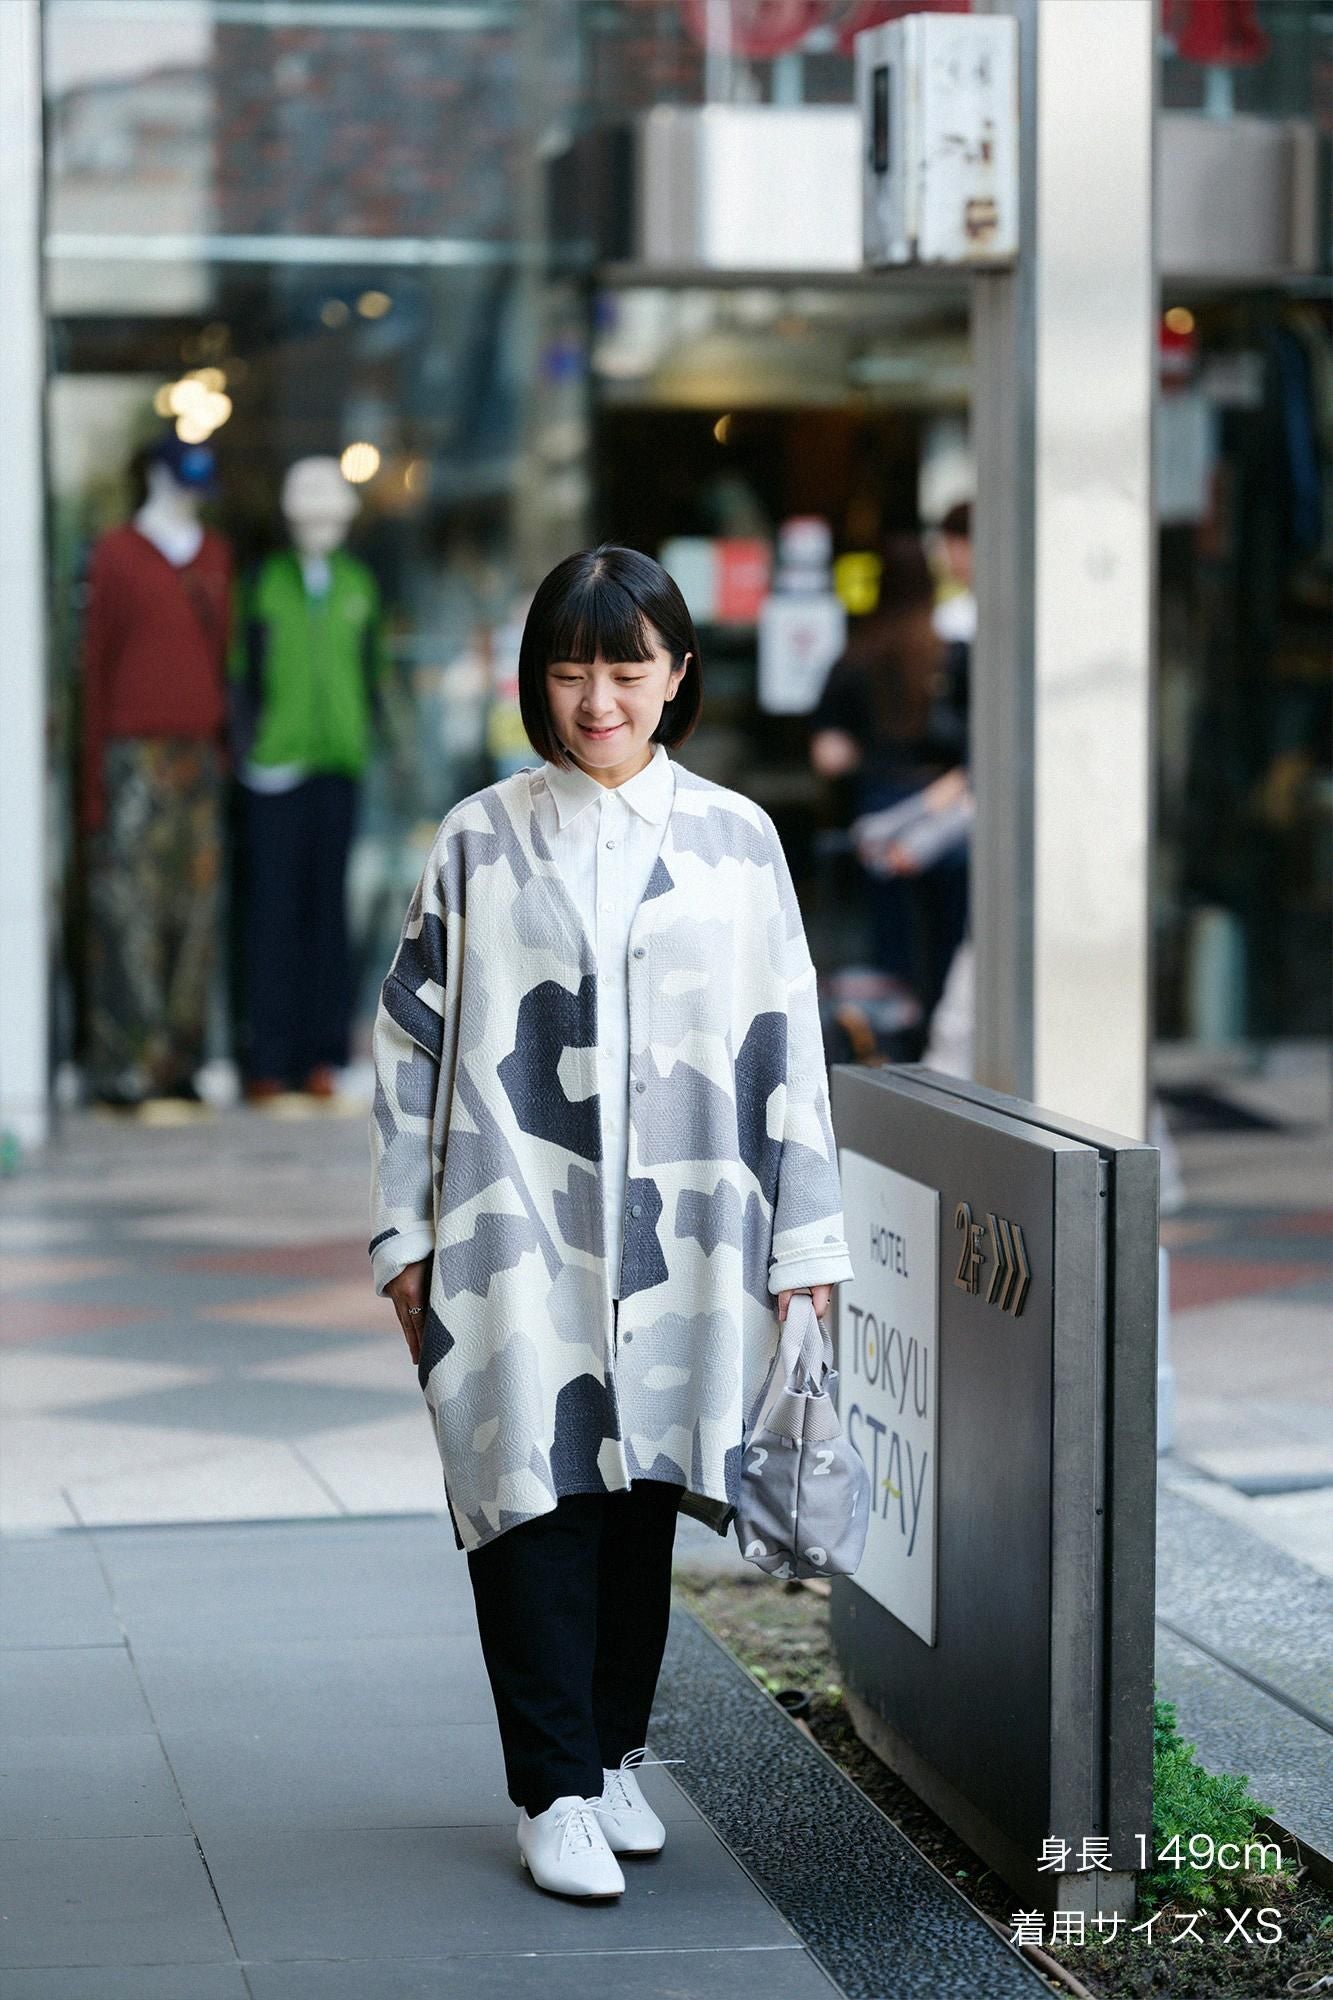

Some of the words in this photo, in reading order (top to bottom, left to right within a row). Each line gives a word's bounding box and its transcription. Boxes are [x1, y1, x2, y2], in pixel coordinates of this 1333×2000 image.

[870, 1222, 909, 1278] HOTEL
[954, 1201, 985, 1294] 2F
[848, 1305, 928, 1419] TOKYU
[747, 1446, 768, 1476] 2
[813, 1450, 834, 1475] 2
